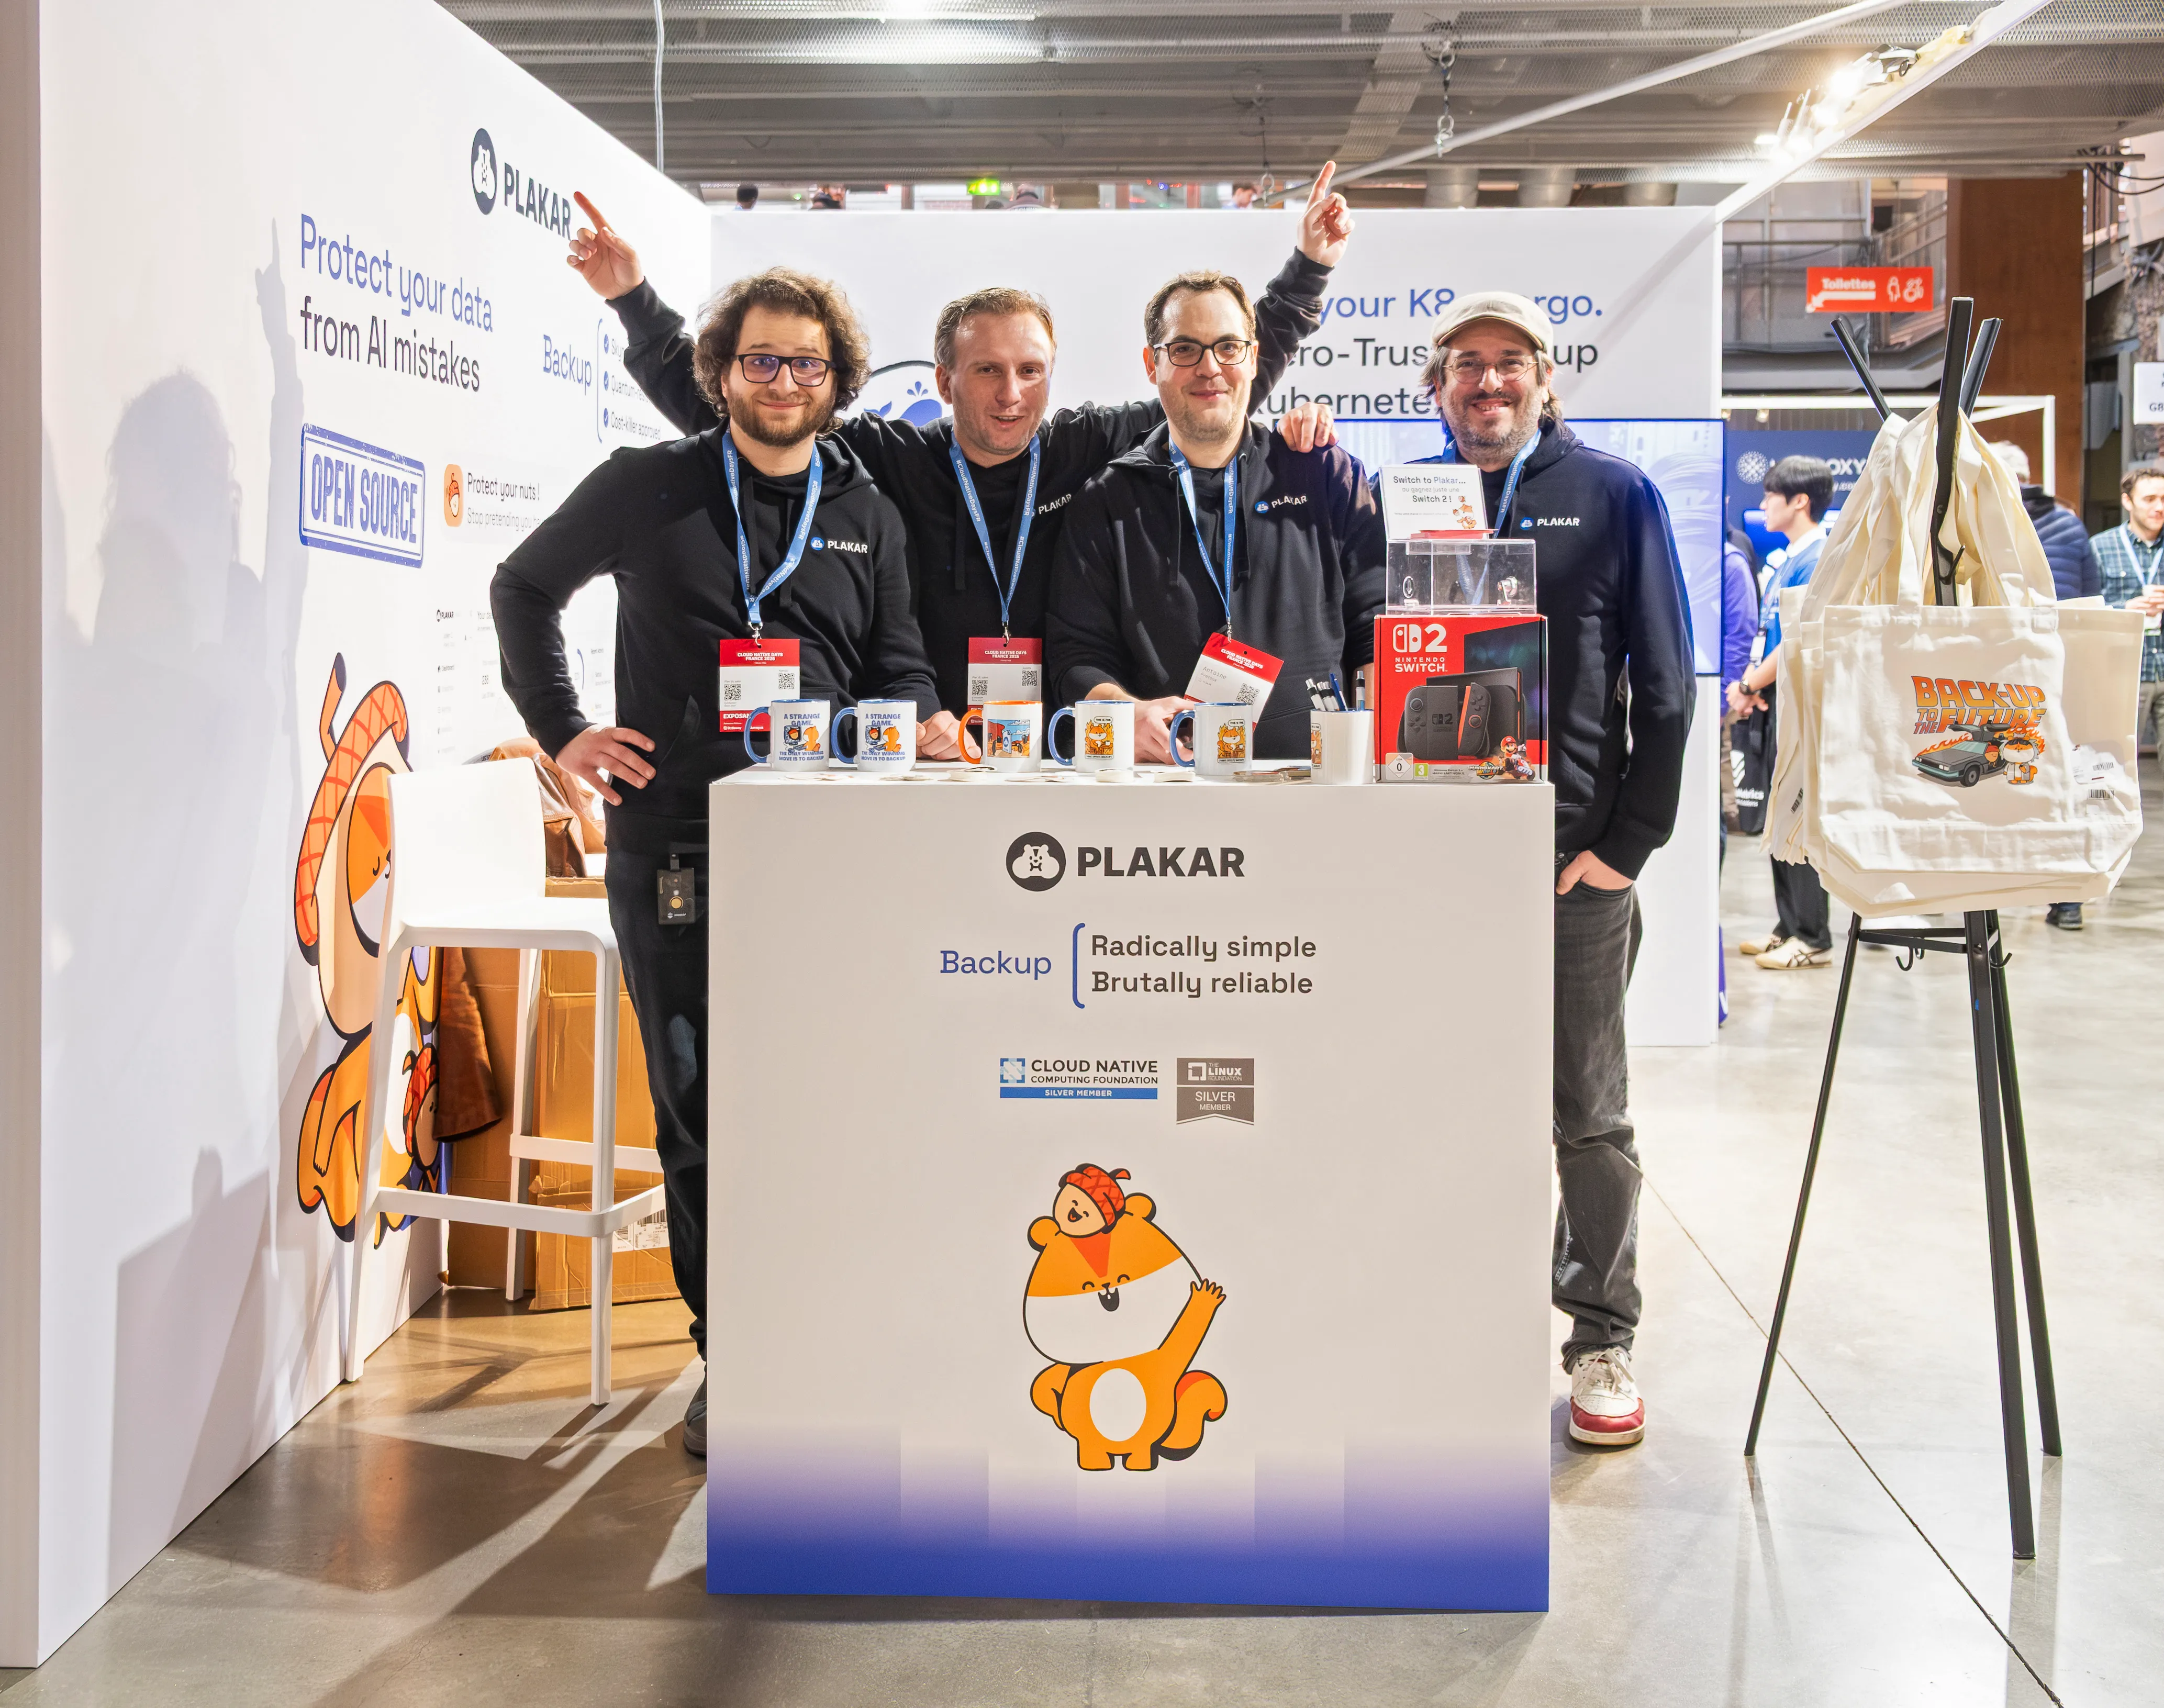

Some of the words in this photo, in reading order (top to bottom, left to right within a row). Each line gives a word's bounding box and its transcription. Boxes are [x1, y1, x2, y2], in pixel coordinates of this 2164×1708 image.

[504, 162, 571, 241] PLAKAR
[301, 213, 392, 297] Protect
[399, 265, 446, 317] your
[452, 277, 493, 332] data
[1822, 277, 1876, 290] Toilettes
[1319, 294, 1396, 326] your
[1410, 288, 1455, 317] K8
[300, 296, 360, 362] from
[367, 315, 387, 369] AI
[394, 329, 480, 393] mistakes
[1288, 338, 1432, 367] ro-Trus
[543, 334, 592, 395] Backup
[1258, 386, 1432, 415] ubernete
[611, 411, 637, 433] Cost-killer
[311, 453, 355, 529] OPEN
[360, 468, 417, 544] SOURCE
[467, 472, 498, 496] Protect
[500, 483, 518, 502] your
[520, 483, 536, 500] nuts
[955, 459, 981, 522] #CloudNativeDaysFR
[1037, 493, 1072, 515] PLAKAR
[467, 507, 483, 528] Stop
[485, 510, 519, 531] pretending
[1537, 517, 1580, 527] PLAKAR
[828, 540, 868, 553] PLAKAR
[1221, 648, 1236, 657] CLOUD
[1235, 654, 1252, 664] NATIVE
[1226, 655, 1244, 665] FRANCE
[1395, 663, 1445, 673] SWITCH
[1911, 675, 2046, 708] BACK-UP
[1917, 708, 1938, 722] TO
[1935, 708, 2047, 733] FUTURE
[1913, 721, 1938, 734] THE
[1397, 763, 1402, 771] 0
[1418, 764, 1425, 776] 3
[1077, 846, 1245, 877] PLAKAR
[1091, 934, 1217, 962] Radically
[1226, 935, 1317, 962] simple
[940, 950, 1052, 980] Backup
[1091, 970, 1202, 998] Brutally
[1211, 971, 1313, 993] reliable
[1031, 1059, 1090, 1073] CLOUD
[1096, 1060, 1158, 1073] NATIVE
[1209, 1067, 1242, 1076] LINUX
[1195, 1091, 1235, 1102] SILVER
